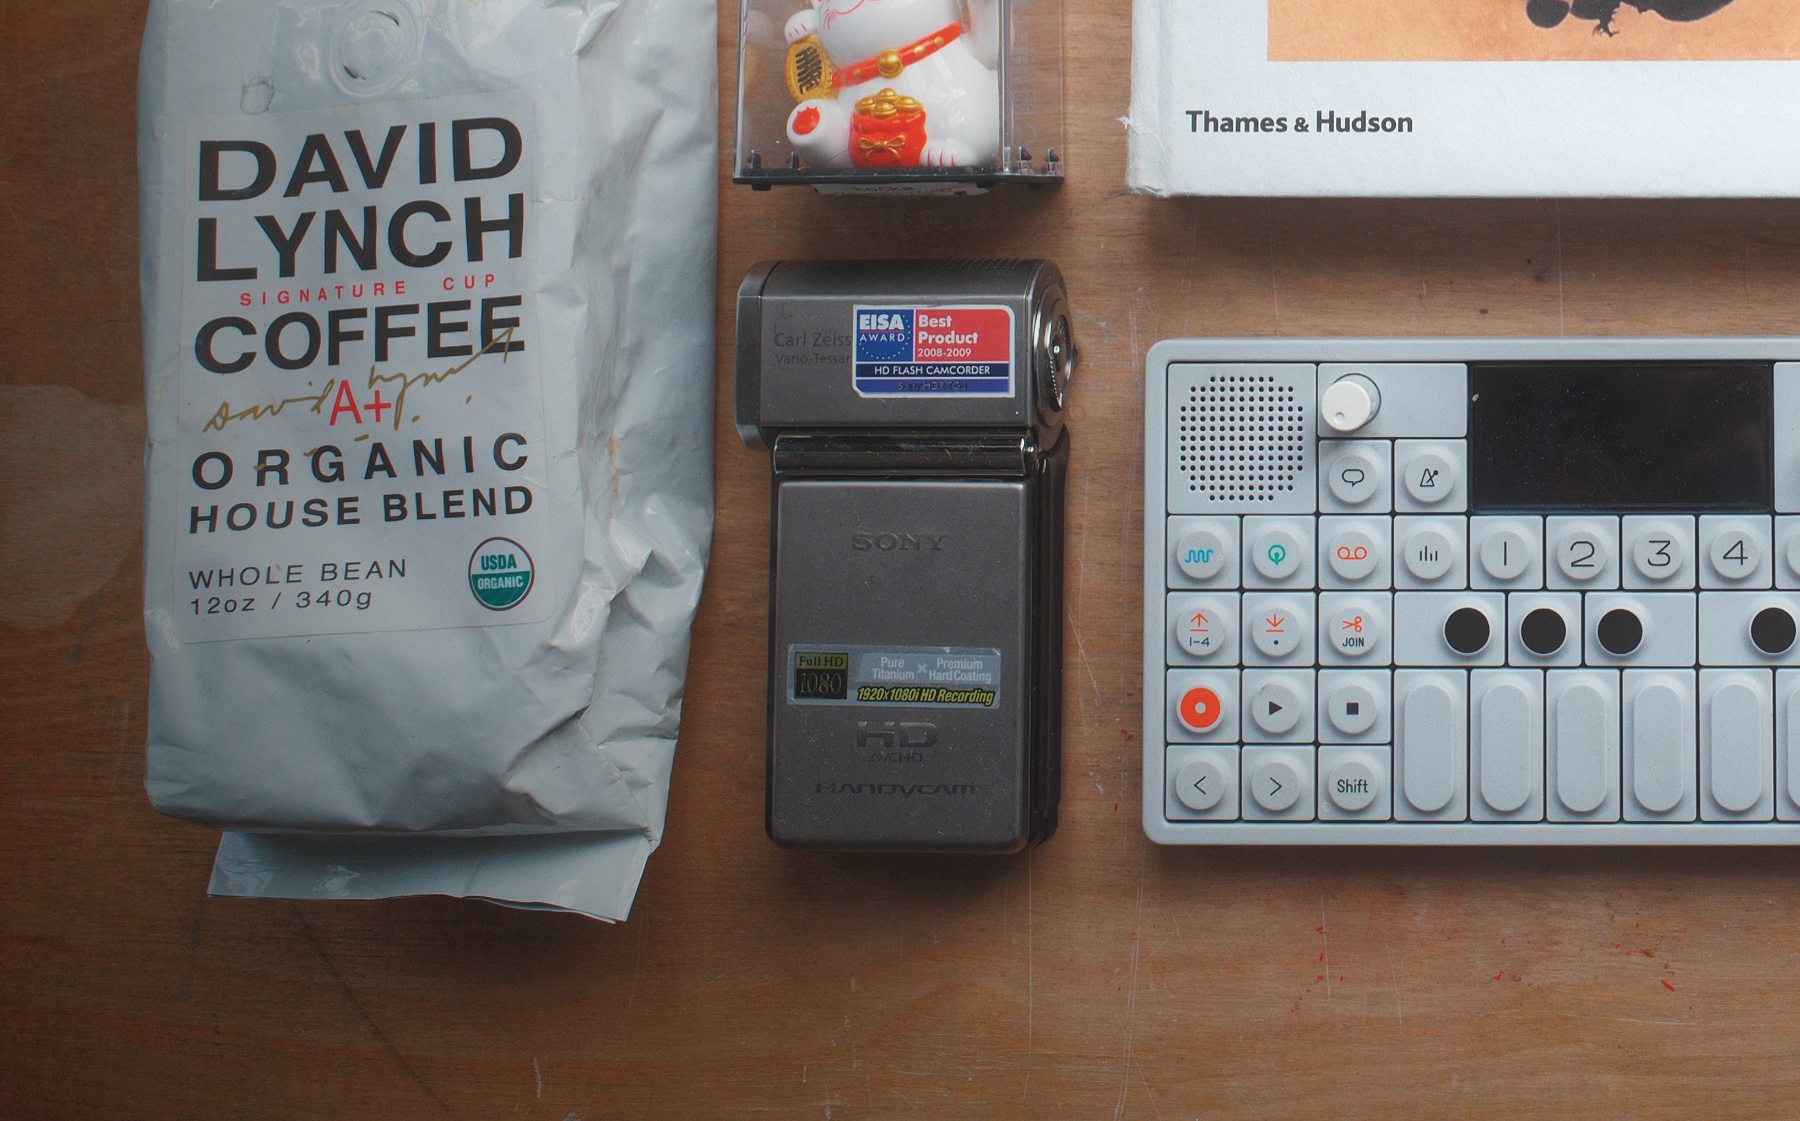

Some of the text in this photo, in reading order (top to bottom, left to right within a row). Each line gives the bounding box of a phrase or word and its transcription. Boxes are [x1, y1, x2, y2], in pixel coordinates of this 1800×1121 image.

[1186, 108, 1414, 134] Thames & Hudson
[198, 117, 523, 201] DAVID
[197, 193, 524, 282] LYNCH
[240, 273, 496, 306] SIGNATURE CUP
[860, 314, 905, 330] EISA
[918, 314, 952, 328] Best
[194, 295, 526, 374] COFFEE
[774, 331, 851, 347] Carl Zeiss
[860, 332, 905, 342] AWARD
[918, 330, 979, 345] Product
[775, 352, 851, 365] Vario-Tessar
[917, 348, 972, 357] 2008-2009
[874, 366, 991, 375] HD FLASH CAMCORDER
[329, 379, 392, 426] A+
[191, 432, 529, 491] ORGANIC
[189, 485, 533, 534] HOUSE BLEND
[852, 532, 947, 551] SONY
[480, 553, 518, 571] USDA
[1570, 541, 1596, 567] 2
[1646, 541, 1671, 567] 3
[1722, 541, 1748, 567] 4
[189, 558, 406, 590] WHOLE BEAN
[477, 574, 524, 590] ORGANIC
[190, 589, 372, 615] 12oz 340g
[1341, 637, 1365, 648] JOIN
[799, 655, 844, 667] Full HD
[881, 656, 905, 668] Pure
[936, 657, 984, 670] Premium
[799, 671, 842, 694] 1080
[872, 668, 915, 680] Titanium
[857, 686, 995, 706] 1920x1080i HD Recording
[857, 721, 938, 748] HD
[869, 752, 924, 763] AVCHD
[1336, 779, 1369, 794] Shift
